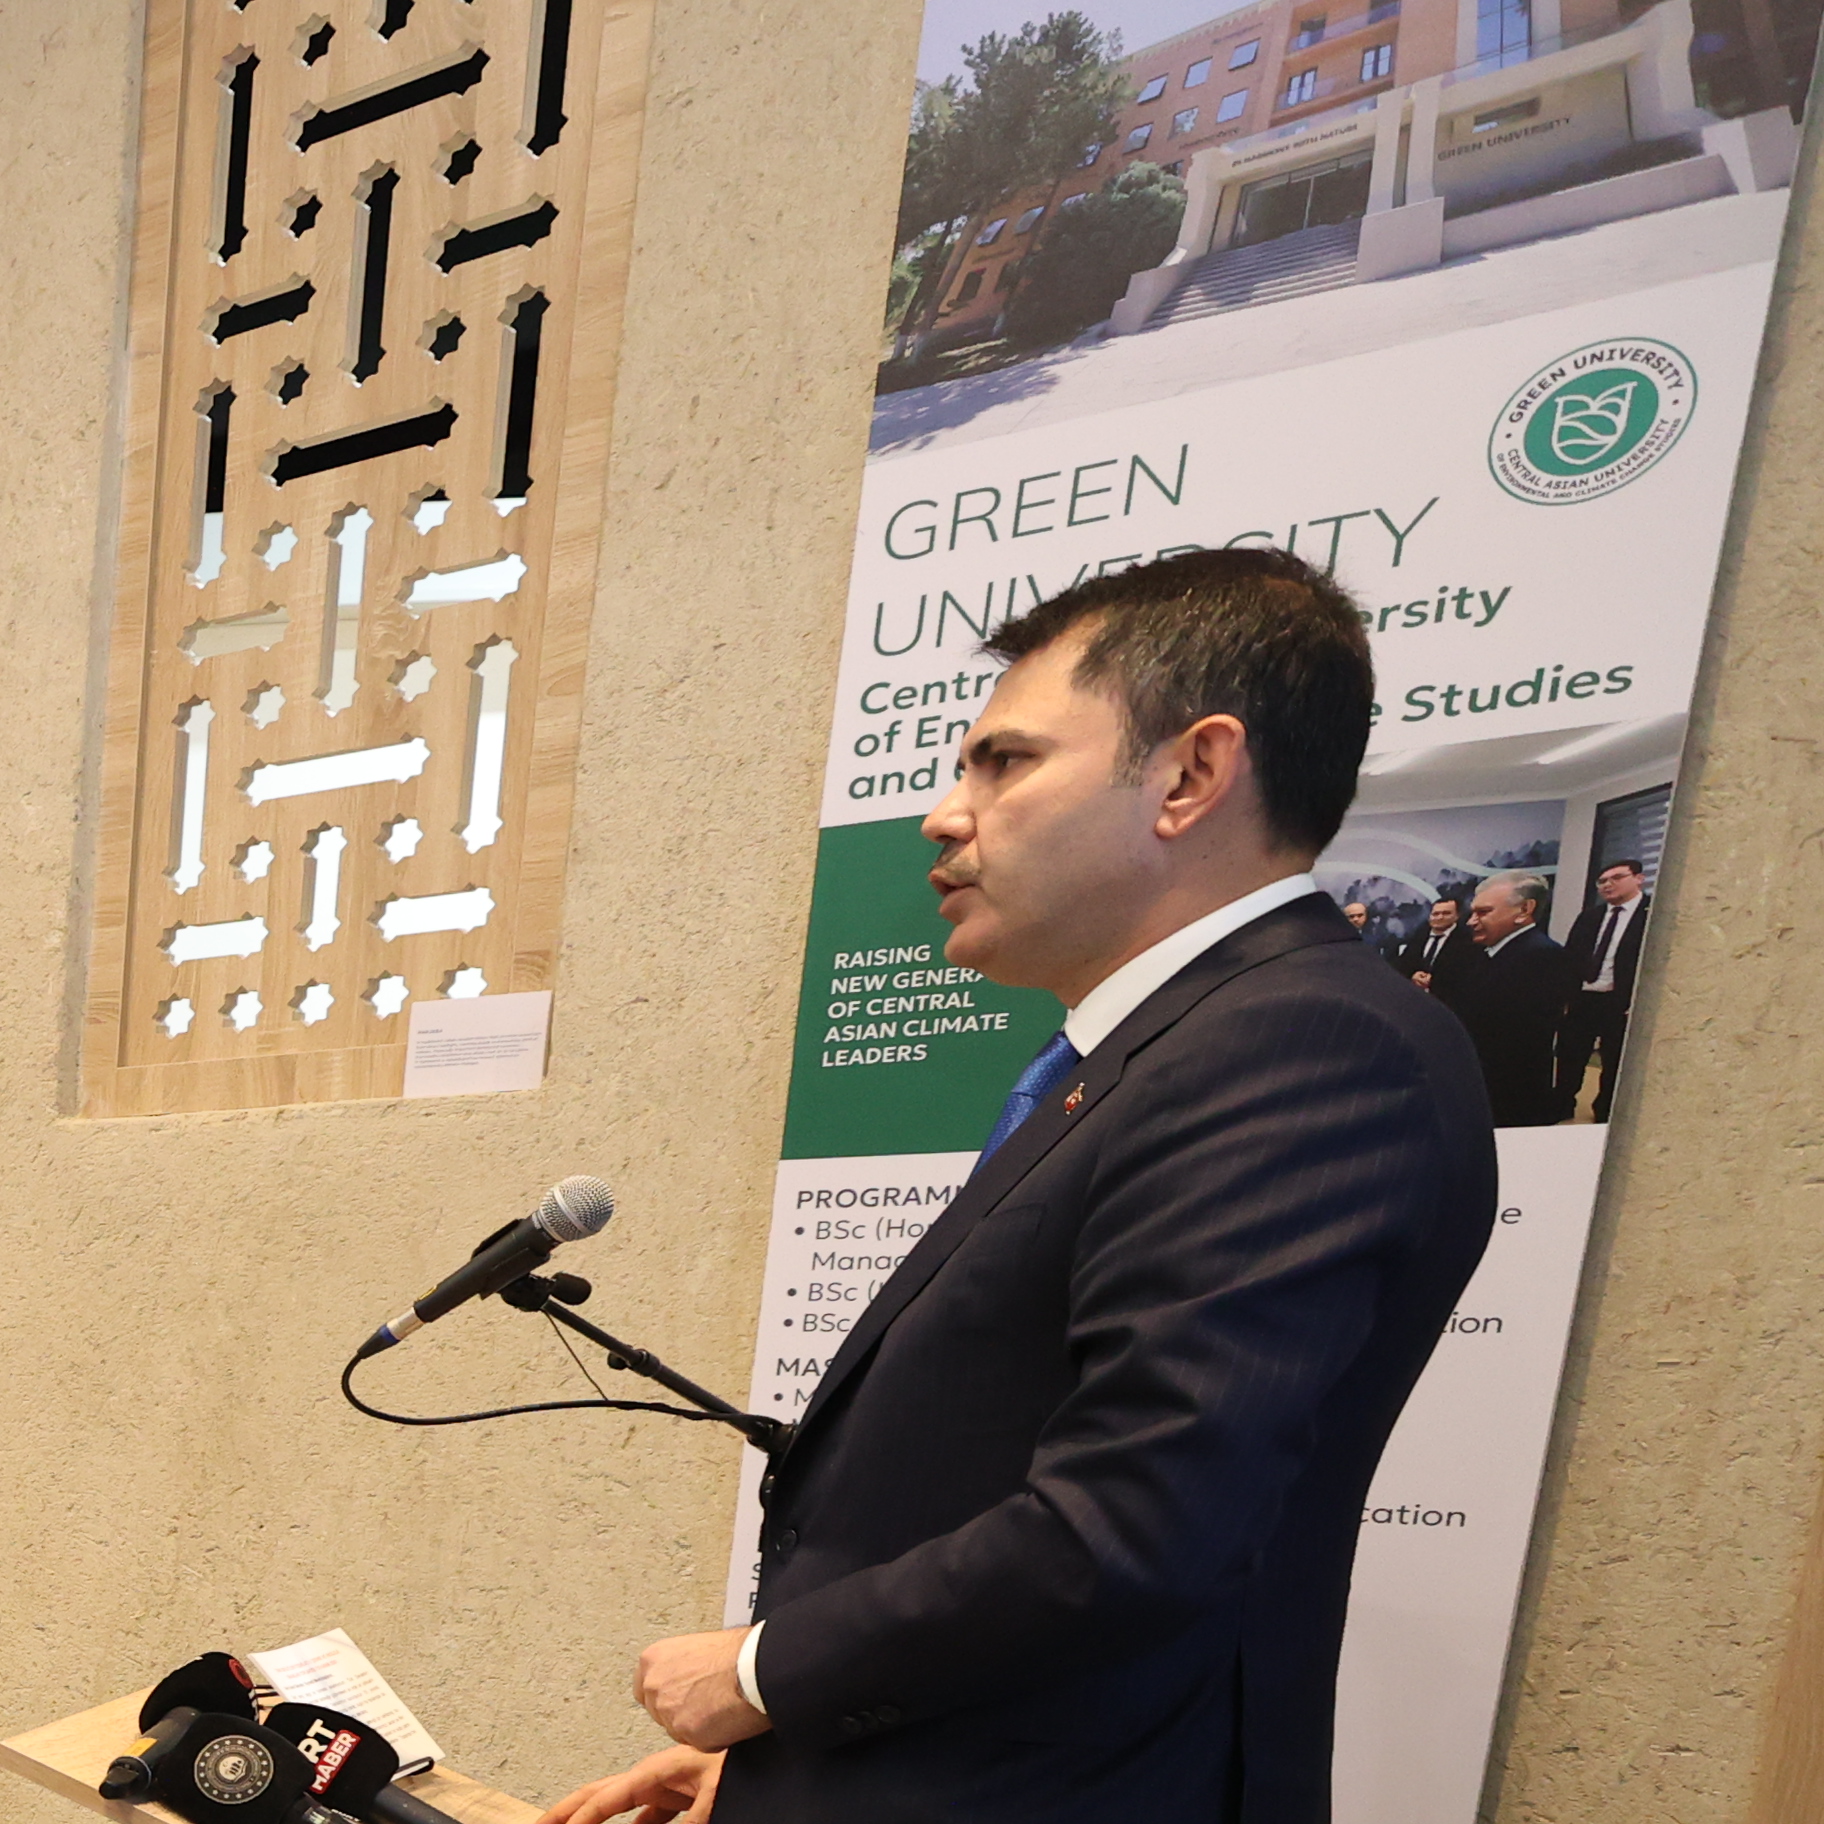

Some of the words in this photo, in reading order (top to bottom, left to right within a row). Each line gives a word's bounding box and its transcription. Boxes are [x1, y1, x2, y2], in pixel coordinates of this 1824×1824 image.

[1509, 367, 1567, 424] GREEN
[1573, 347, 1684, 391] UNIVERSITY
[1507, 448, 1541, 488] CENTRAL
[1543, 477, 1589, 491] ASIAN
[1594, 418, 1670, 483] UNIVERSITY
[884, 444, 1189, 561] GREEN
[859, 667, 1003, 716] Centr
[848, 758, 938, 800] and
[1401, 664, 1634, 722] Studies
[854, 718, 900, 758] of
[834, 944, 931, 970] RAISING
[830, 973, 888, 995] NEW
[827, 1000, 860, 1020] OF
[865, 991, 976, 1018] CENTRAL
[823, 1022, 897, 1044] ASIAN
[902, 1012, 1010, 1038] CLIMATE
[821, 1044, 928, 1068] LEADERS
[814, 1220, 867, 1241] BSc
[808, 1283, 859, 1302] BSc
[803, 1313, 851, 1333] BSc
[297, 1719, 337, 1764] RT
